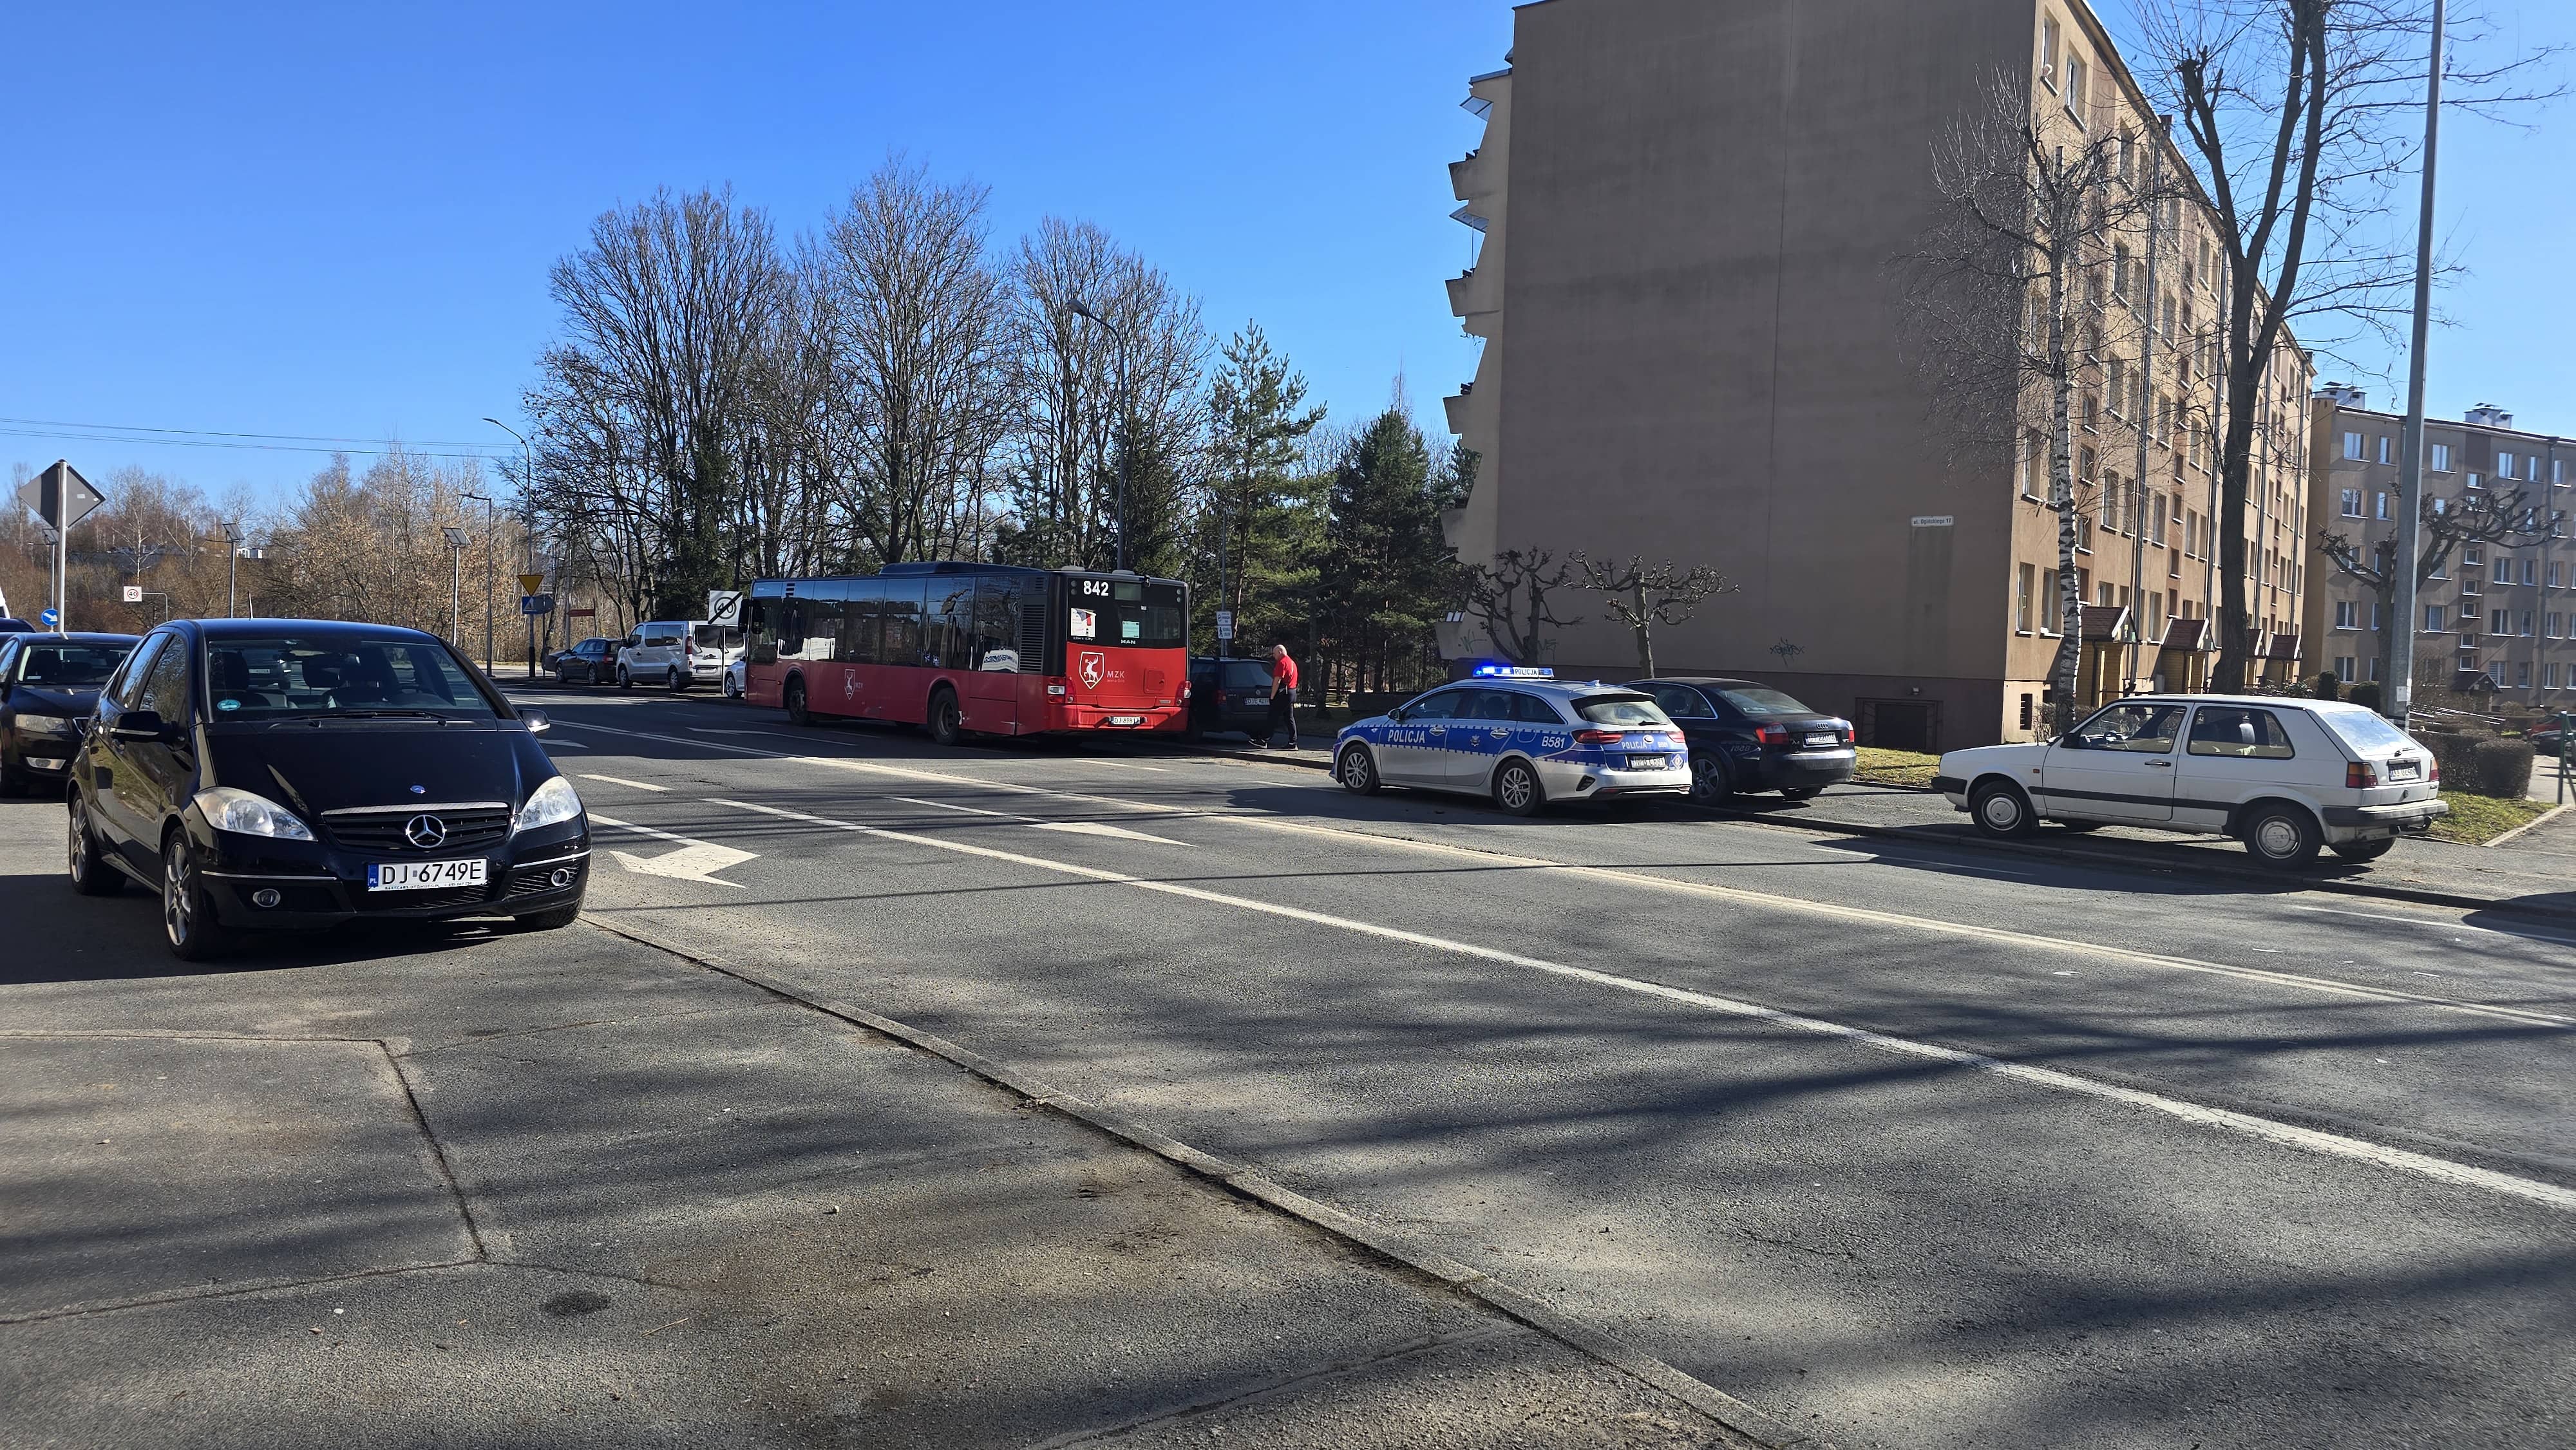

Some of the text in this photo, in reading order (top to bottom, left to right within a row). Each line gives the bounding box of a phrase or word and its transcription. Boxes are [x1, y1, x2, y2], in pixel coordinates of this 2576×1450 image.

[1083, 581, 1109, 596] 842
[1107, 670, 1125, 679] MZK
[1387, 729, 1426, 744] POLICJA
[1541, 735, 1566, 749] B581
[1622, 741, 1648, 749] POLICJA
[383, 861, 482, 885] DJ 6749E
